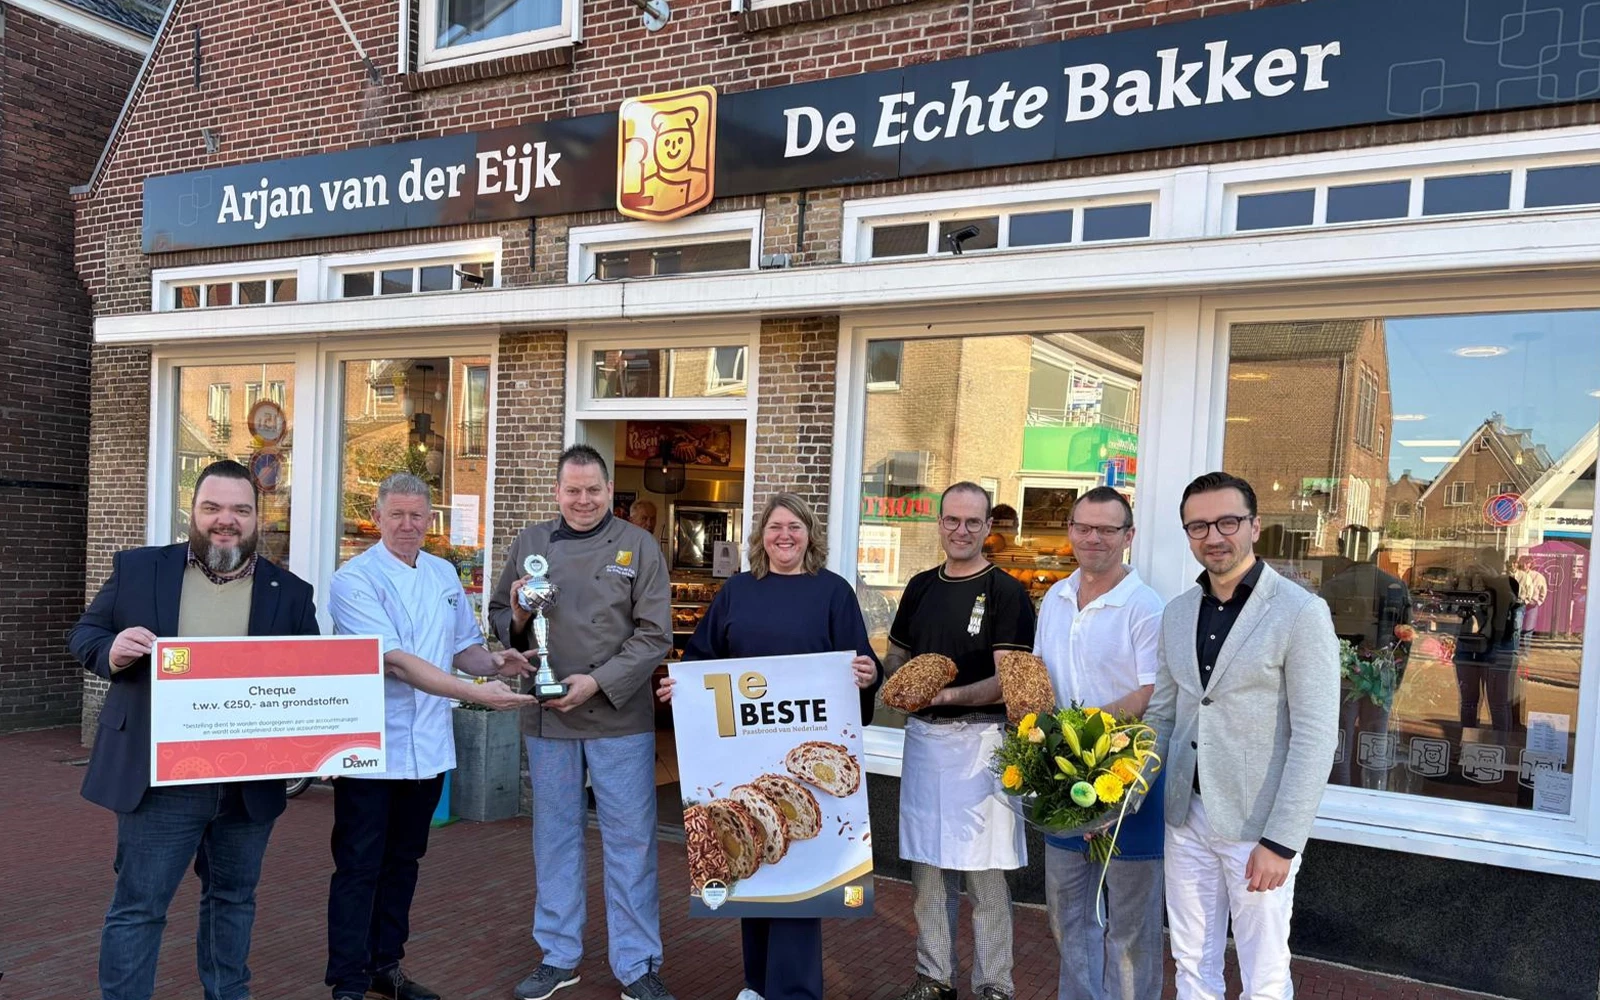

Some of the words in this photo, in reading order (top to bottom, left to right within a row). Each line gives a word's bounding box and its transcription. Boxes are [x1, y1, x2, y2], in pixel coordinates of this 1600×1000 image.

[784, 106, 856, 159] De
[873, 79, 1049, 149] Echte
[1064, 40, 1341, 123] Bakker
[216, 177, 314, 230] Arjan
[319, 176, 390, 213] van
[399, 157, 465, 205] der
[476, 138, 562, 203] Eijk
[248, 686, 296, 698] Cheque
[192, 702, 220, 711] t.w.v.
[223, 700, 257, 710] €250,-
[259, 700, 280, 708] aan
[282, 697, 349, 710] grondstoffen
[740, 698, 827, 726] BESTE
[742, 726, 778, 735] Paasbrood
[792, 724, 829, 733] Nederland
[342, 757, 379, 769] Dawn
